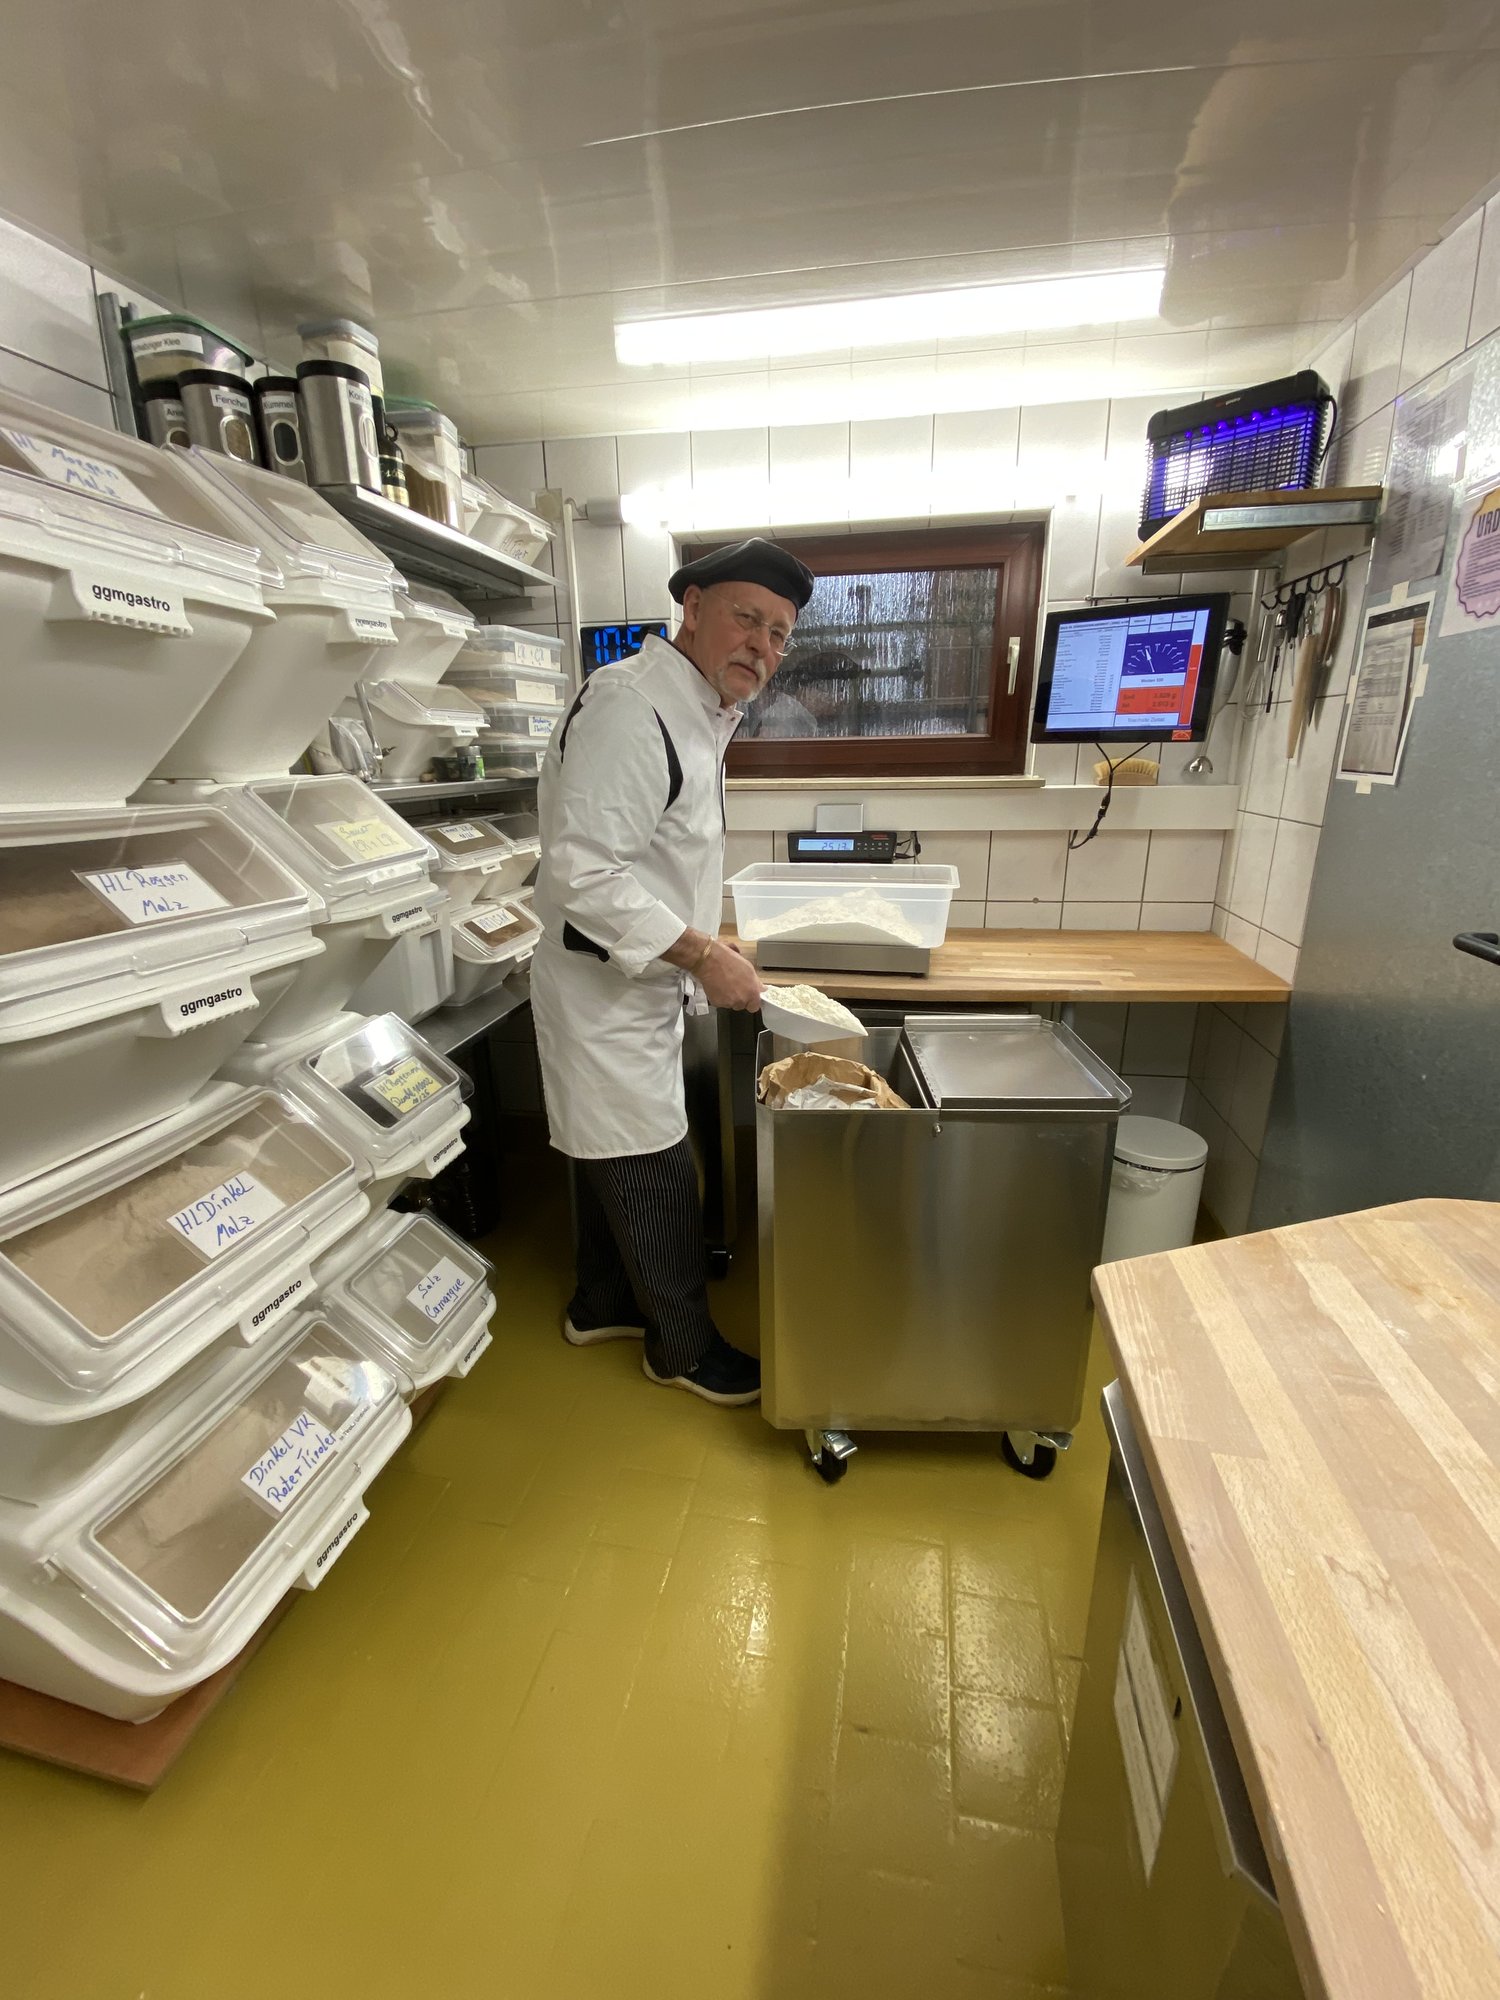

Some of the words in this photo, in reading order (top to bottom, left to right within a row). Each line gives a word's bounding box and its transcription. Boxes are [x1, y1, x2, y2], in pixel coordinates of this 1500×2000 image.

[215, 393, 248, 410] Fenchel
[92, 584, 171, 611] ggmgastro
[594, 625, 665, 664] 10:5
[97, 874, 133, 894] HL
[143, 897, 189, 916] Malz
[391, 906, 422, 923] ggmgastro
[180, 988, 242, 1016] ggmgastro
[432, 1137, 458, 1163] ggmgastro
[195, 1176, 255, 1223] Dinkel
[216, 1215, 255, 1246] Malz
[417, 1273, 442, 1299] Salz
[424, 1278, 465, 1318] Camargue
[252, 1279, 302, 1326] ggmgastro
[463, 1331, 486, 1363] ggmgastro
[249, 1436, 294, 1485] Dinkel
[289, 1413, 316, 1438] VK
[267, 1464, 303, 1503] Roter
[296, 1433, 337, 1469] Tiroler
[316, 1512, 358, 1568] ggmgastro
